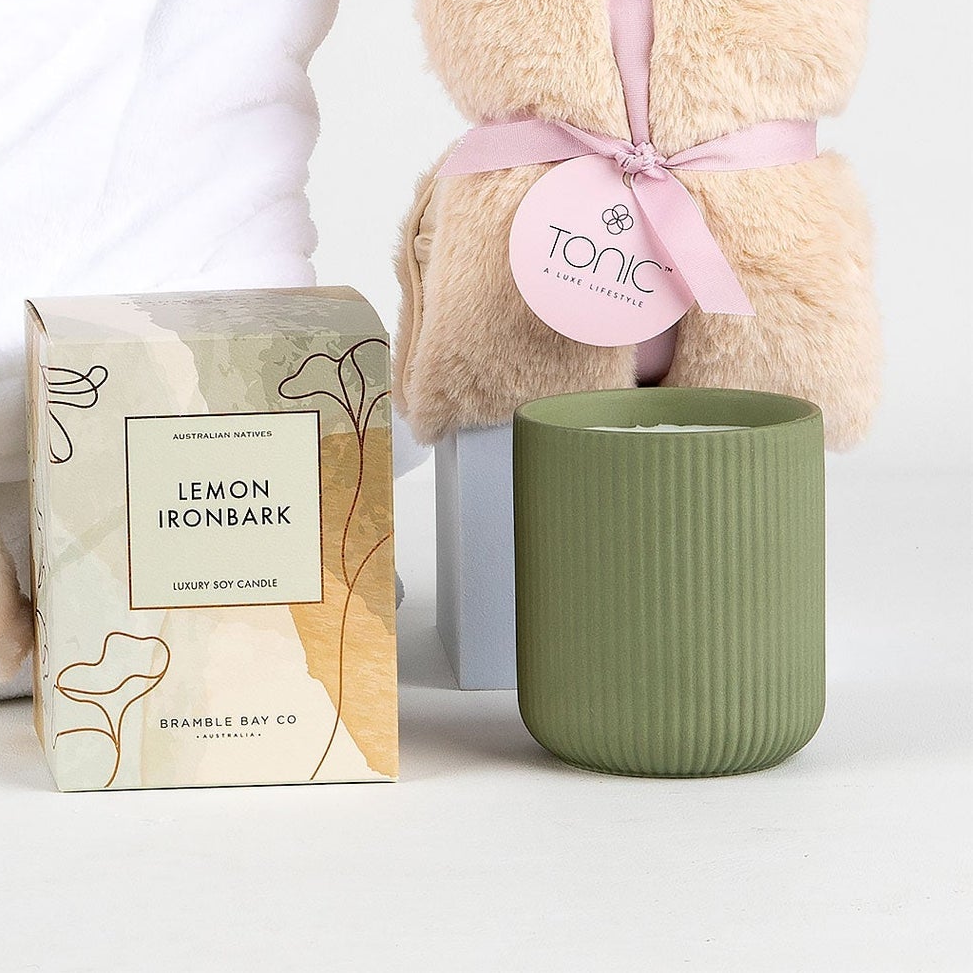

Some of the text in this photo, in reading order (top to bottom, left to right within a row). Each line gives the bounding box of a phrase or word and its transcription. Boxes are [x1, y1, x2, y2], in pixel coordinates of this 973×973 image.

[543, 267, 644, 309] A LUXE LIFESTYLE
[172, 430, 273, 440] AUSTRALIAN NATIVES
[179, 479, 269, 500] LEMON
[158, 505, 291, 528] IRONBARK
[173, 578, 278, 591] LUXURY SOY CANDLE
[160, 714, 297, 729] BRAMBLE BAY CO
